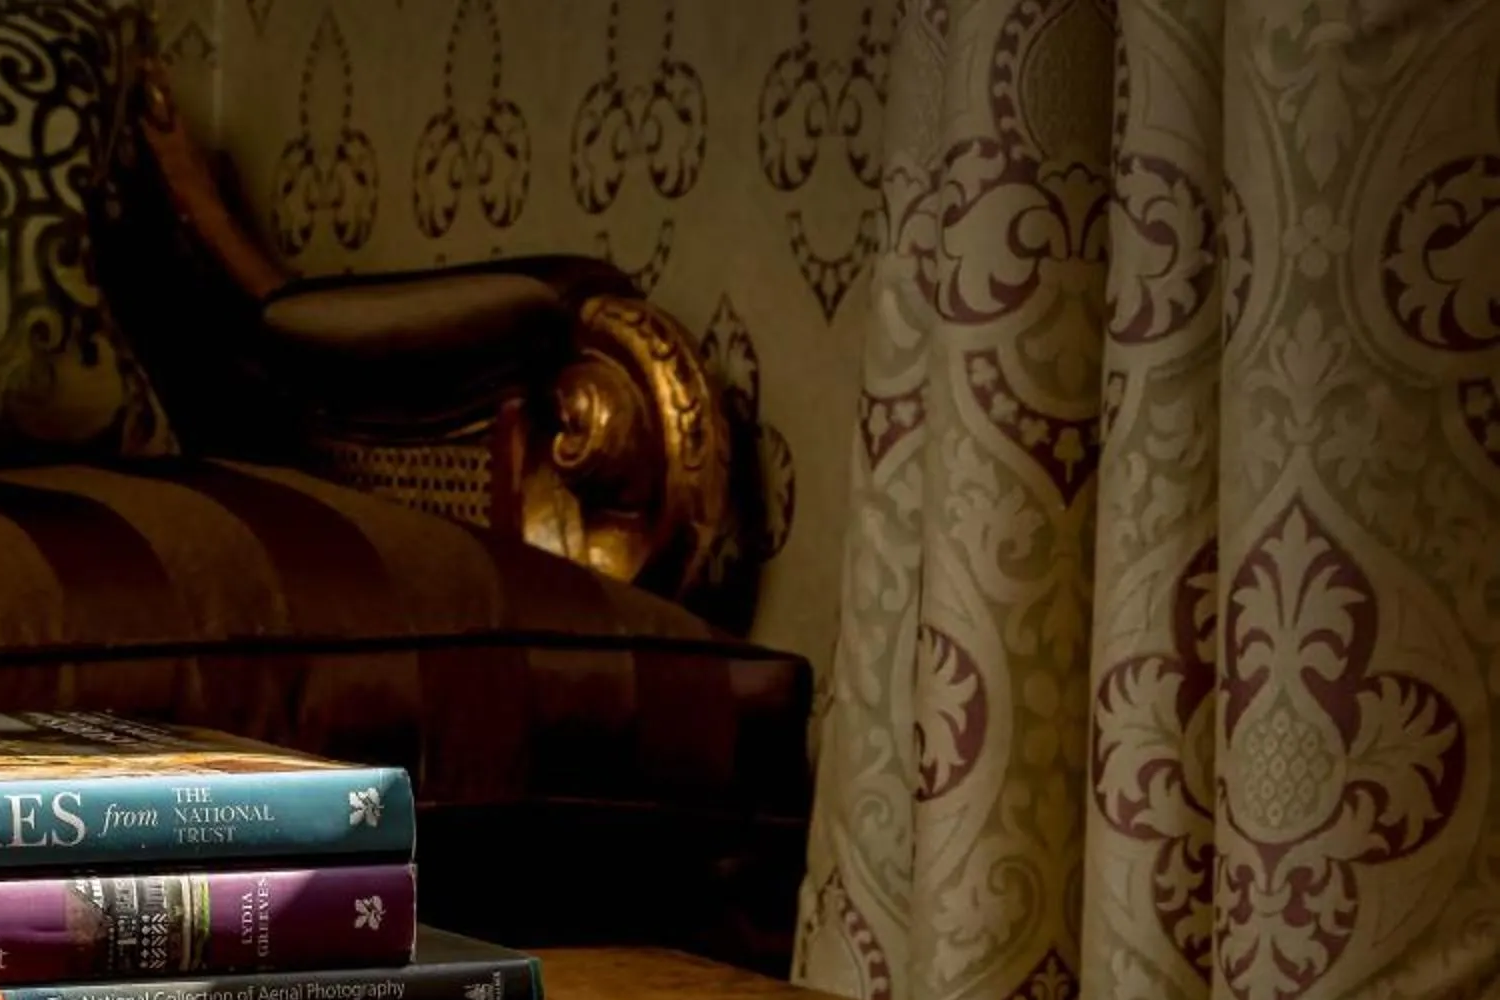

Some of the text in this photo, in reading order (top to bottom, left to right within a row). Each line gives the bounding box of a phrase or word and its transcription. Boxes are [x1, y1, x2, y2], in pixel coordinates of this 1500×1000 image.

[171, 787, 211, 803] THE
[98, 803, 159, 838] from
[174, 804, 275, 824] NATIONAL
[173, 825, 237, 845] TRUST
[241, 892, 253, 945] LYDIA
